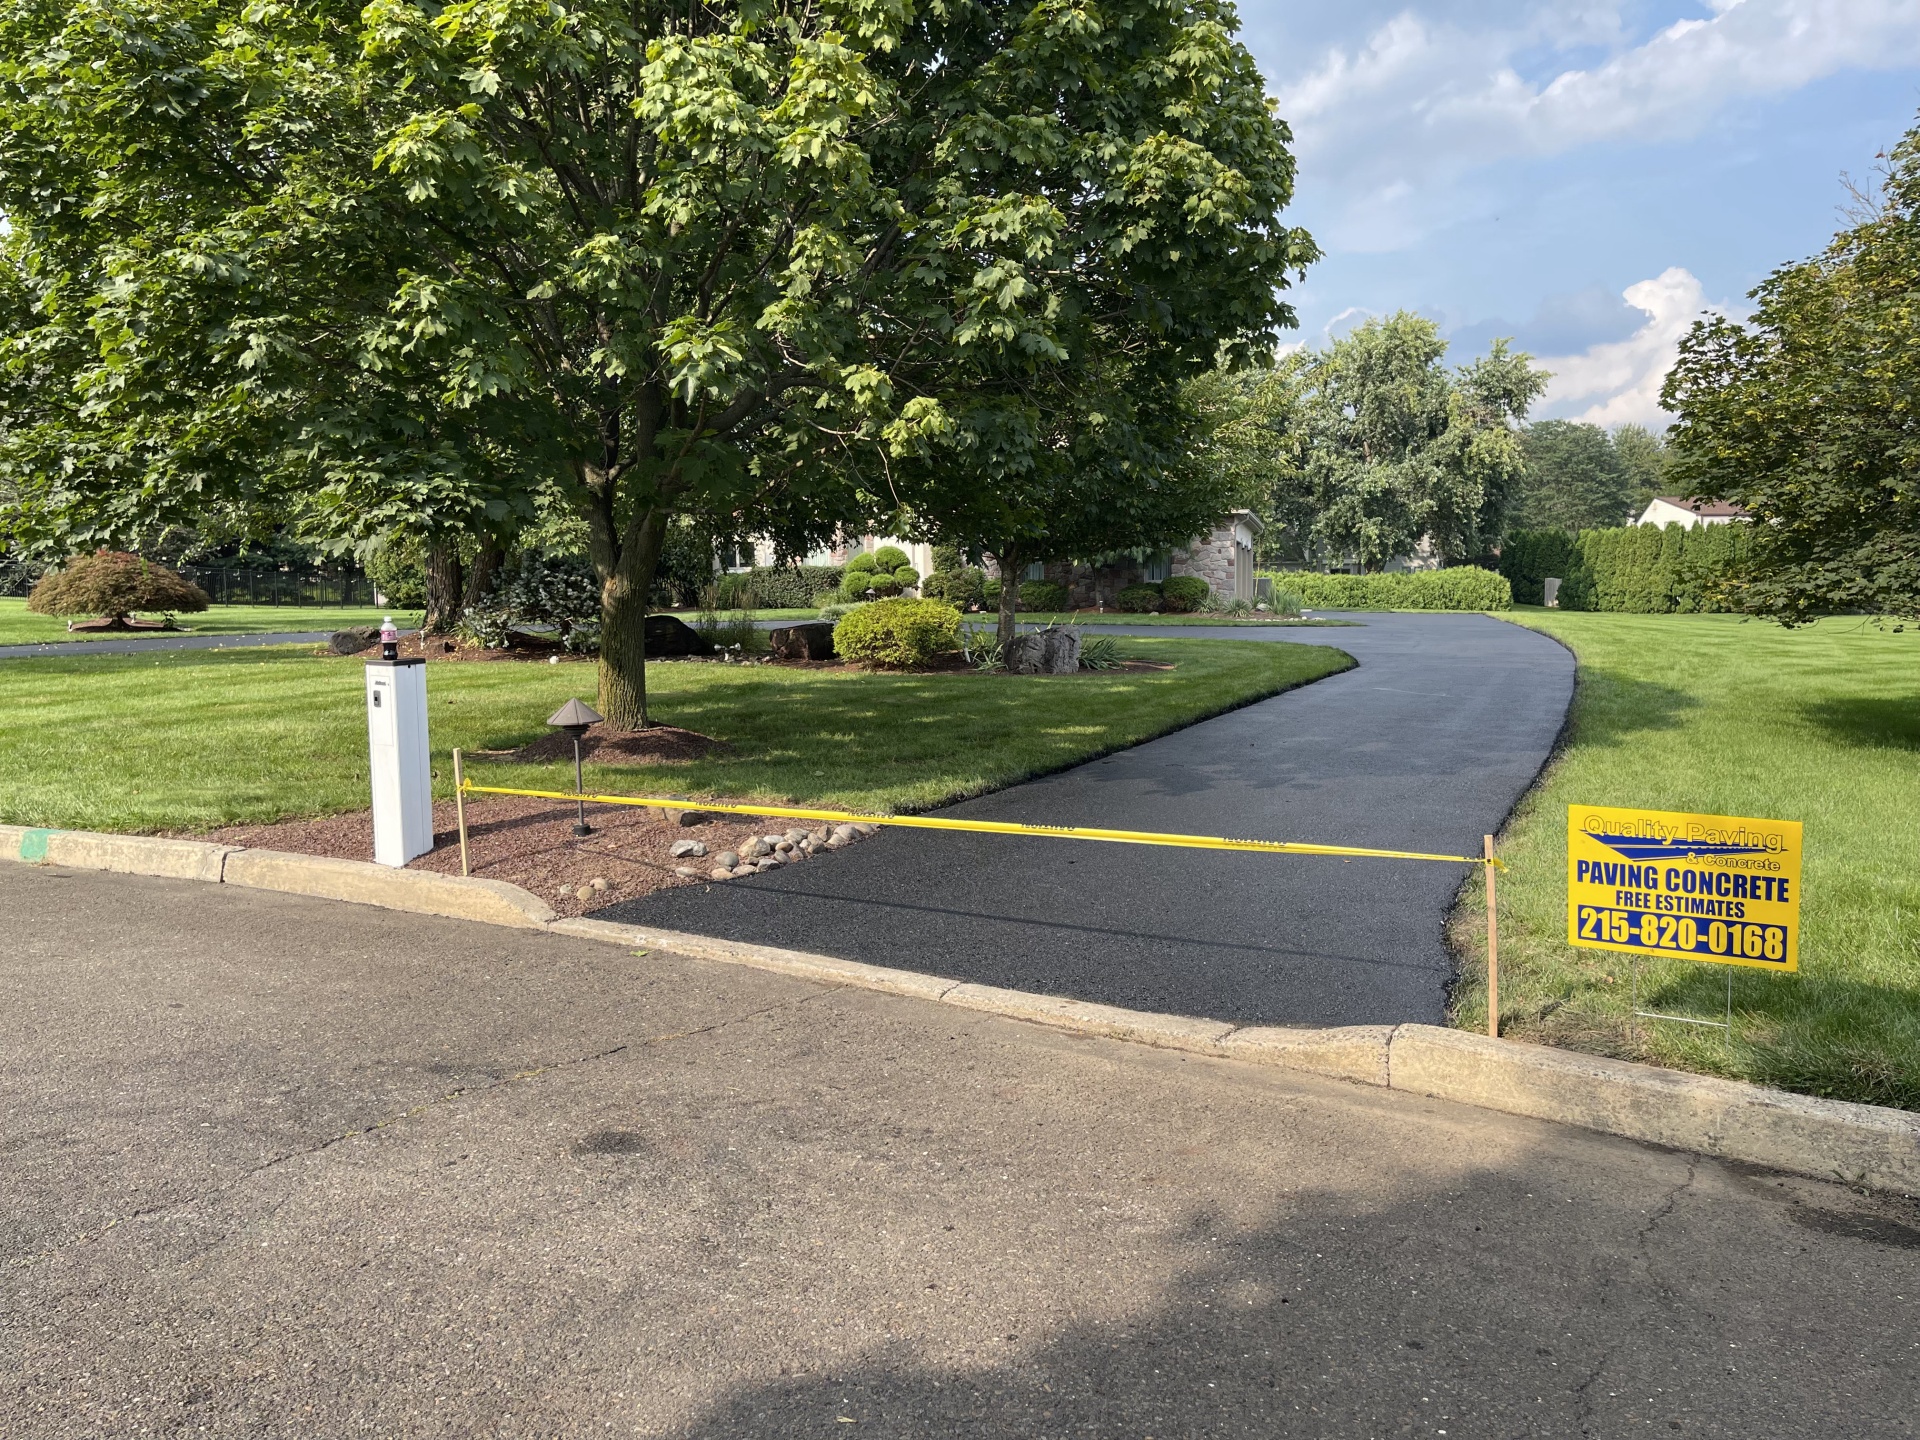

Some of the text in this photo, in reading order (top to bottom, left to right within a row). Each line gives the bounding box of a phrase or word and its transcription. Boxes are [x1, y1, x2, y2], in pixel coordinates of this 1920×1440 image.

[1583, 814, 1784, 855] Quality Paving
[1577, 859, 1790, 903] PAVING CONCRETE
[1685, 851, 1781, 872] & Concrete
[1615, 890, 1745, 919] FREE ESTIMATES
[1580, 907, 1784, 960] 215-820-0168
